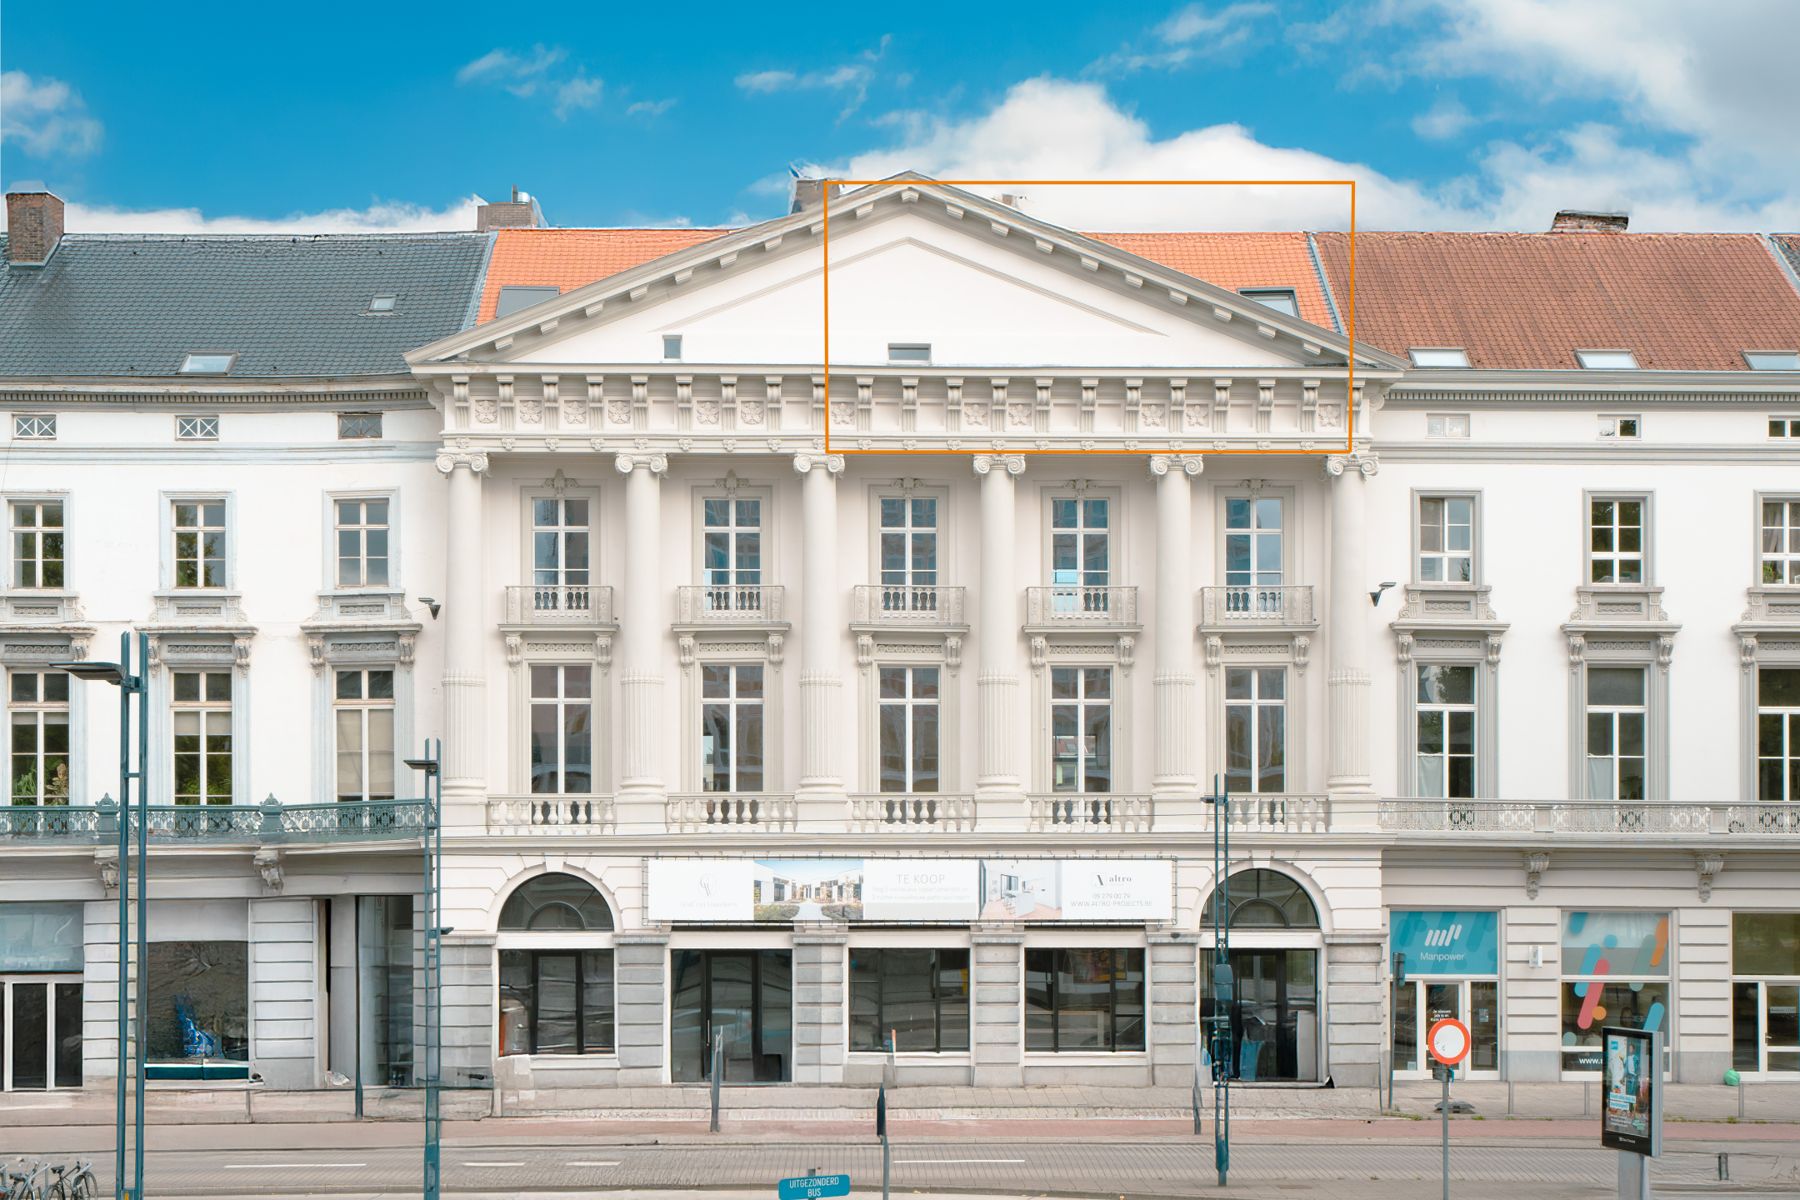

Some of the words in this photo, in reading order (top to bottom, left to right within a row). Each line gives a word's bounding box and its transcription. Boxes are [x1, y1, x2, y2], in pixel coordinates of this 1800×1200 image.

[896, 874, 910, 885] TE
[913, 874, 945, 885] KOOP
[1420, 952, 1465, 963] Manpower
[789, 1177, 839, 1188] UITGEZONDERD
[808, 1188, 822, 1197] BUS
